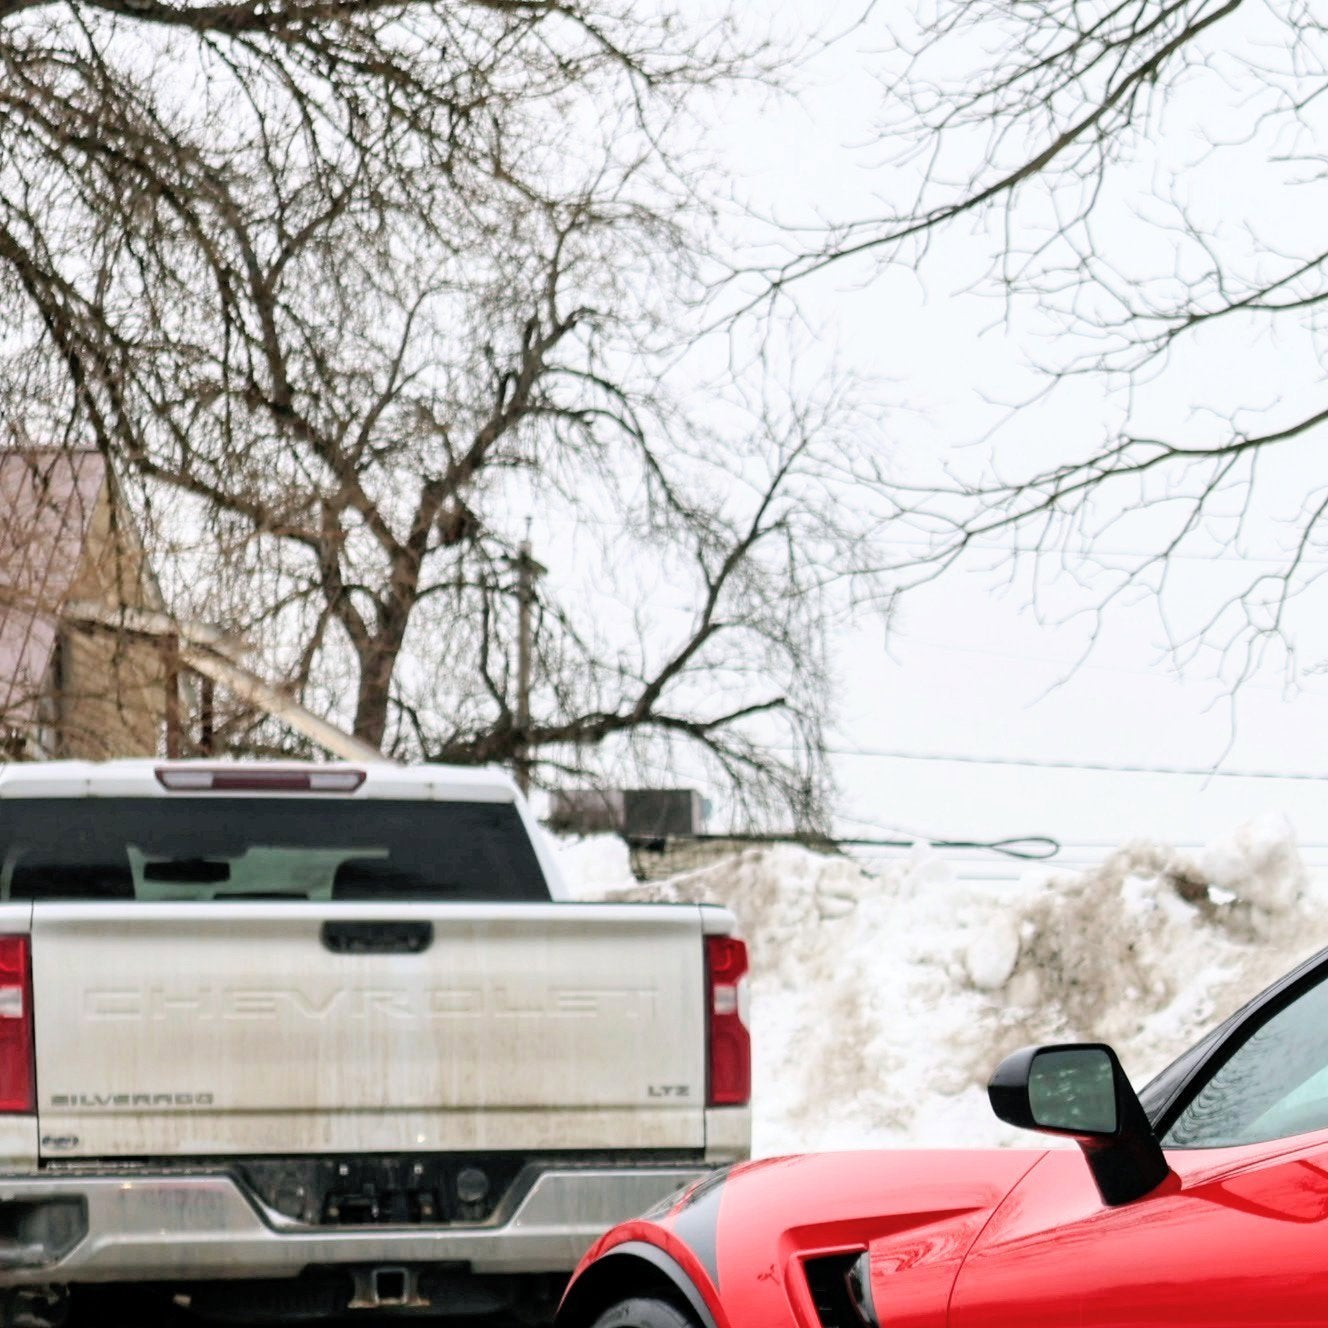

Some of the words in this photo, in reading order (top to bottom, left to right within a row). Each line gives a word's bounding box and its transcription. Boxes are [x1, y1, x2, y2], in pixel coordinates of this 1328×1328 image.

[84, 985, 658, 1021] CHEVROLET
[648, 1085, 690, 1097] LTZ
[50, 1093, 214, 1106] SILVERADO
